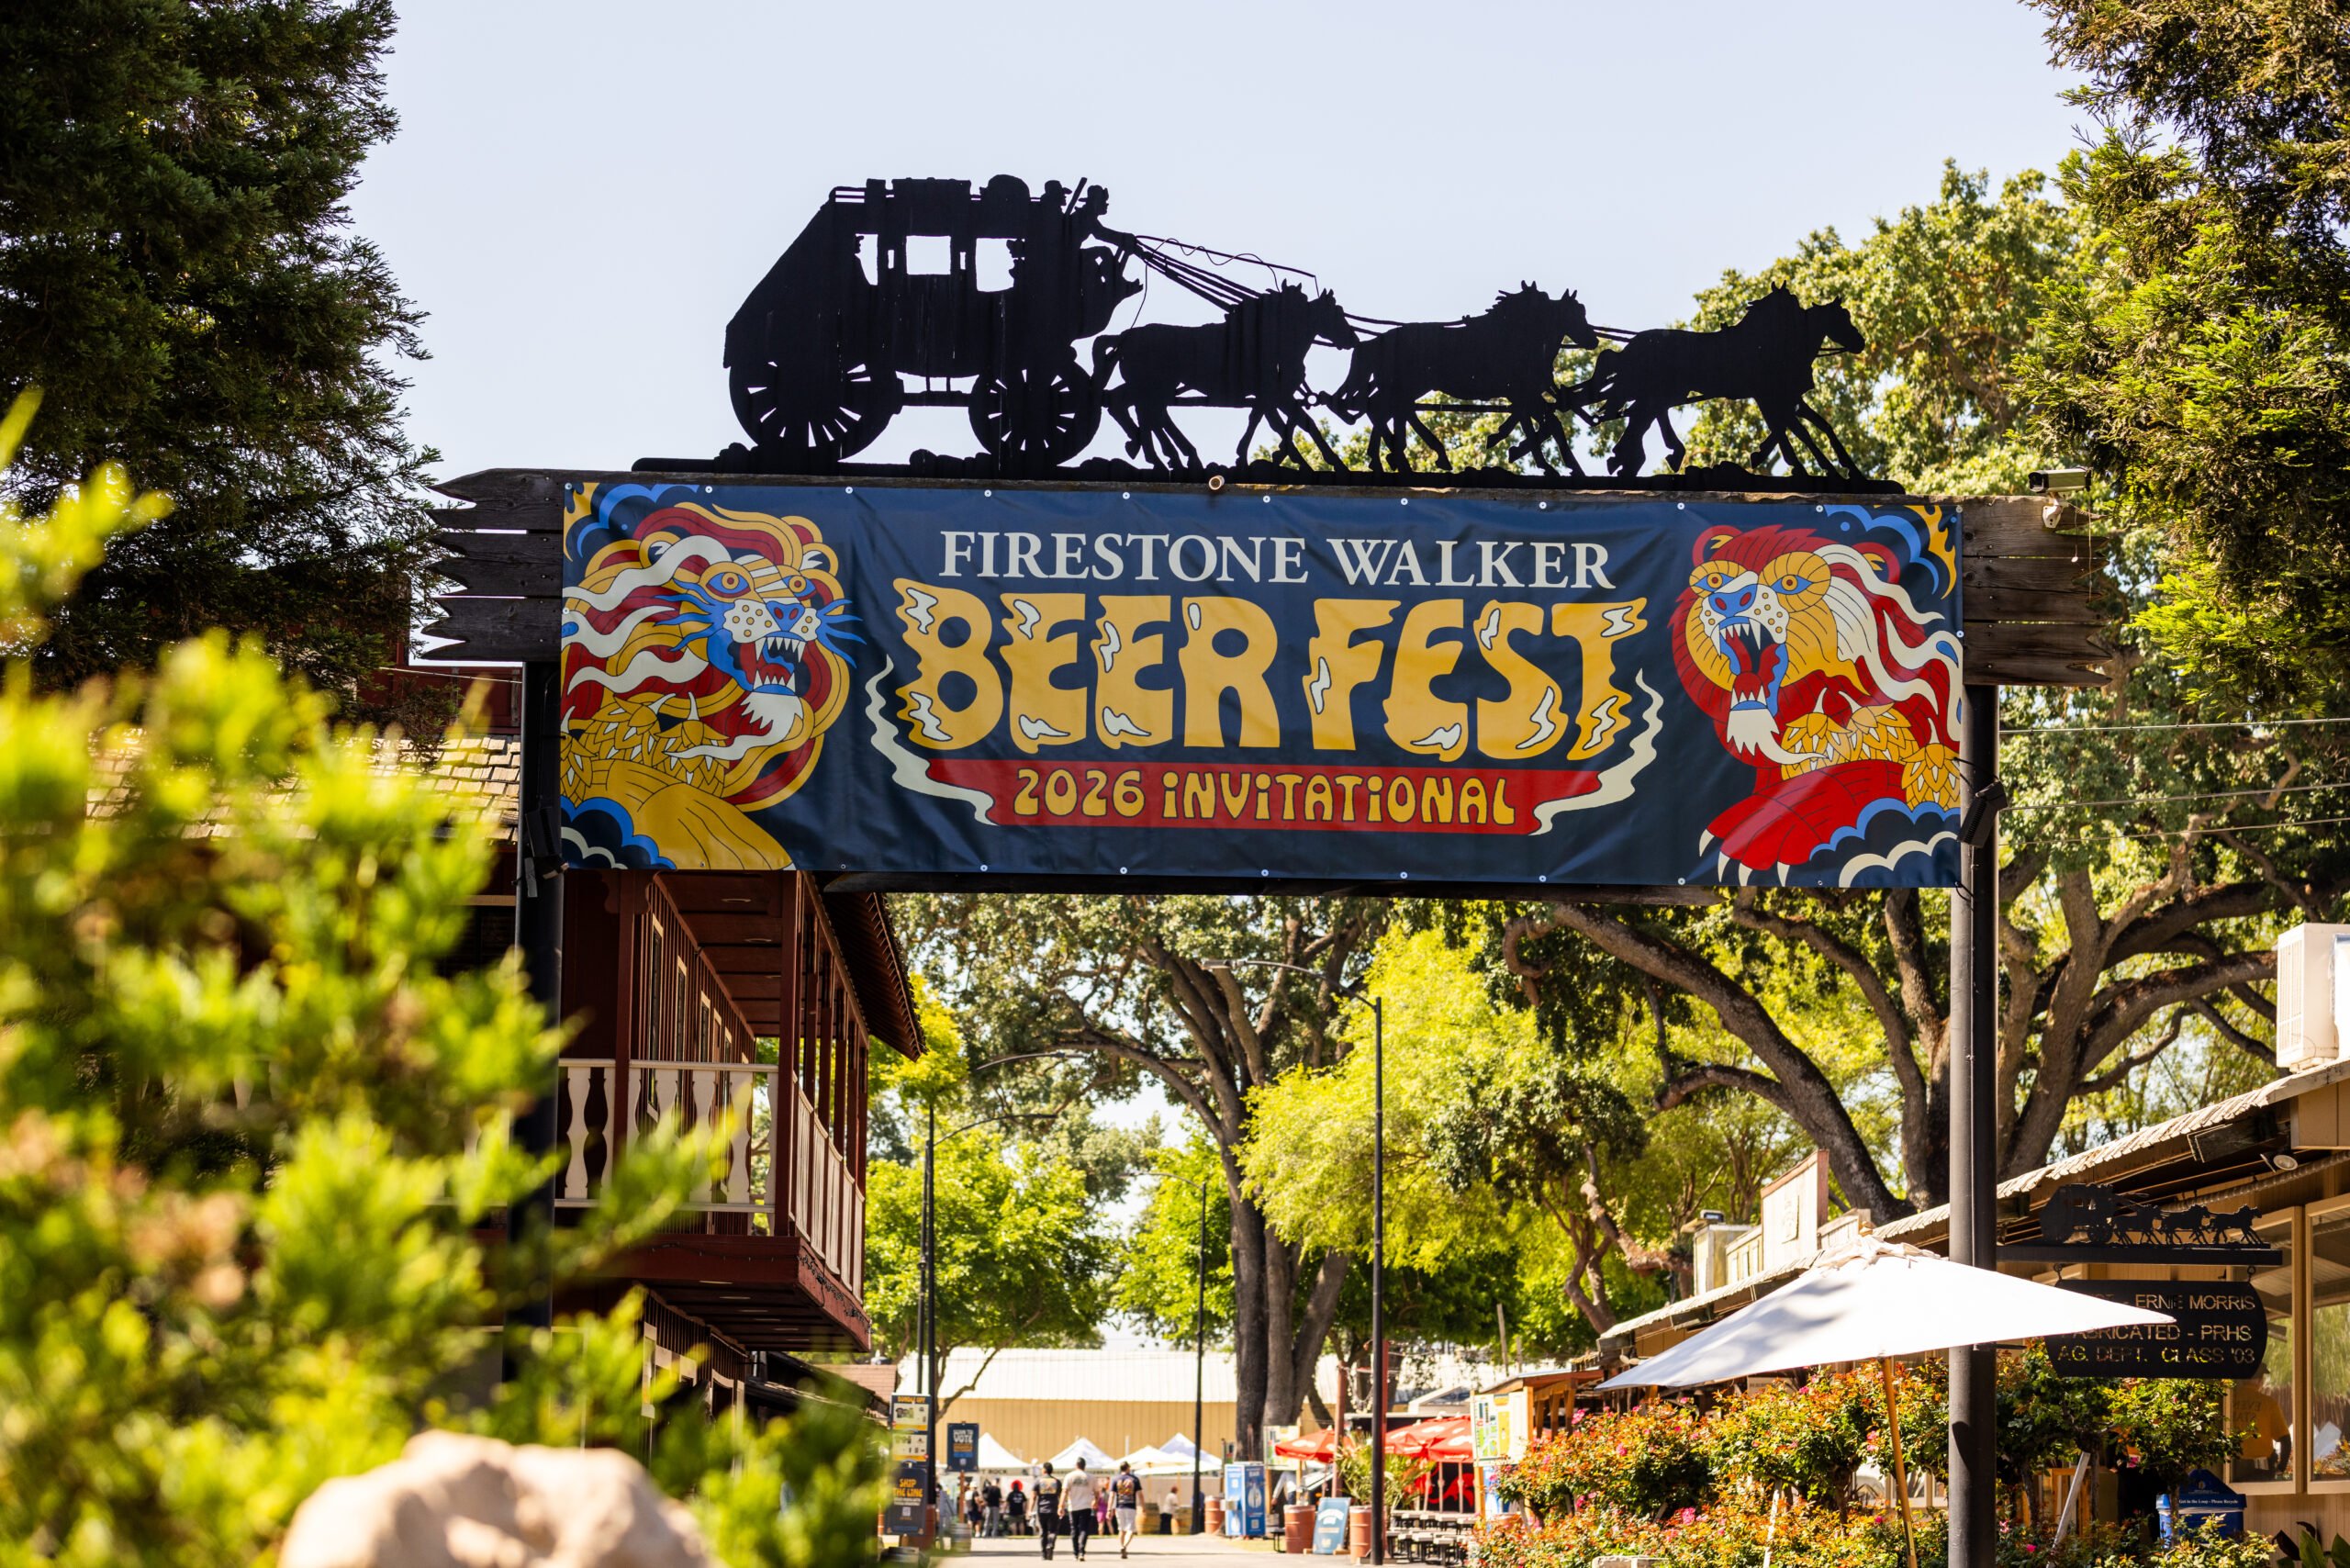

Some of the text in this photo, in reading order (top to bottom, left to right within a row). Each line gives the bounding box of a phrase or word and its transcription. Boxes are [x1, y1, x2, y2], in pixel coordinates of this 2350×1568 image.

[938, 531, 1617, 589] FIRESTONE WALKER
[894, 578, 1649, 762] BEER FEST
[1013, 767, 1146, 818] 2026
[2134, 1294, 2184, 1310] ERNIE
[2188, 1294, 2255, 1311] MORRIS
[2062, 1324, 2181, 1341] ABRICATED
[2200, 1325, 2253, 1341] PRHS
[2161, 1347, 2225, 1364] CLASS
[2231, 1347, 2255, 1364] '03
